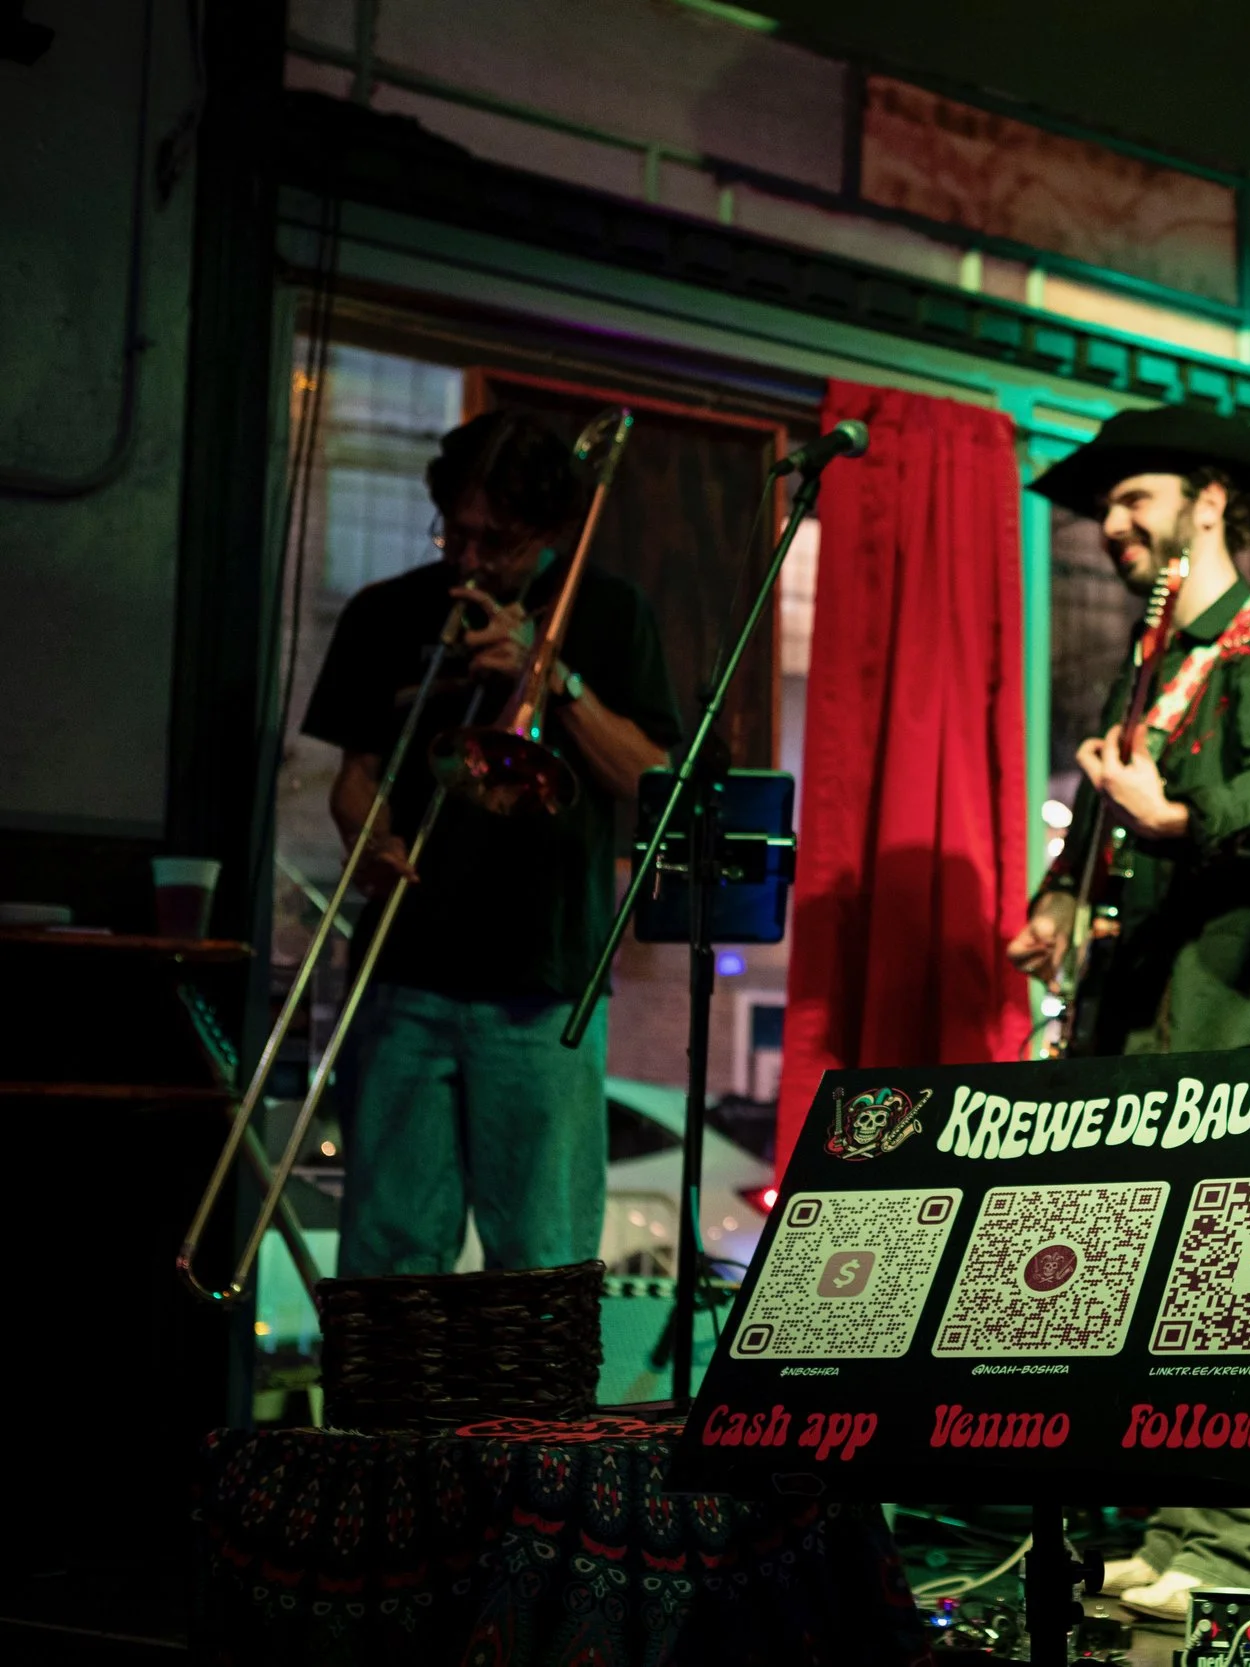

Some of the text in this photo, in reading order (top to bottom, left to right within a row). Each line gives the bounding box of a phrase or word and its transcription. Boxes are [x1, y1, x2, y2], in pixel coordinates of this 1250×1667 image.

[936, 1085, 1109, 1160] KREWE
[1105, 1091, 1168, 1148] DE
[780, 1366, 840, 1378] $NBOSHRA
[971, 1364, 1070, 1376] @NOAH-BOSHRA
[702, 1404, 878, 1461] Cash app
[930, 1404, 1070, 1448] Venmo
